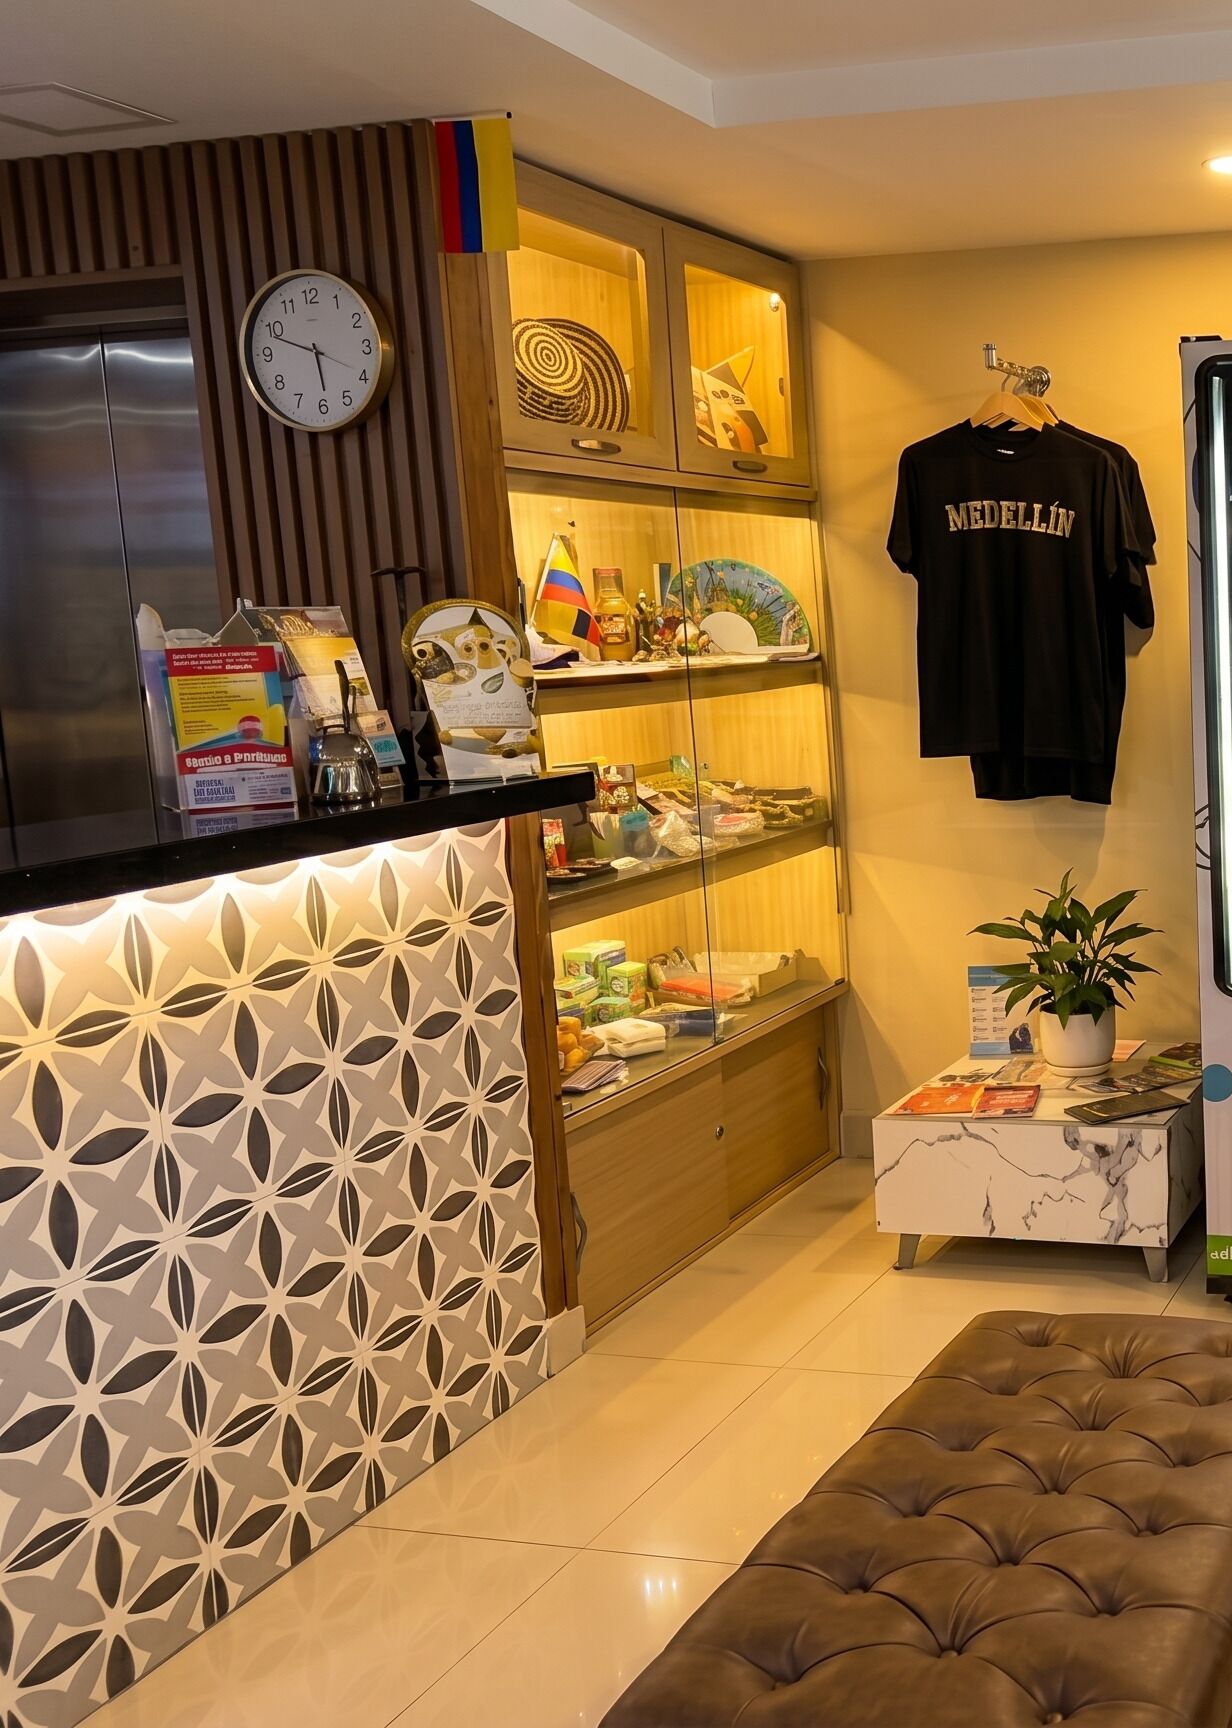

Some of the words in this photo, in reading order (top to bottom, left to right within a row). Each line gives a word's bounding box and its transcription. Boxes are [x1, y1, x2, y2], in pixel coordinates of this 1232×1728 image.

[301, 287, 319, 305] 12
[332, 294, 339, 310] 1
[280, 298, 295, 315] 11
[265, 320, 284, 338] 10
[351, 312, 362, 329] 2
[262, 346, 273, 363] 9
[361, 338, 372, 355] 3
[274, 374, 285, 390] 8
[358, 369, 369, 384] 4
[293, 393, 304, 409] 7
[318, 398, 329, 415] 6
[342, 390, 353, 407] 5
[945, 500, 1076, 539] MEDELLÍN
